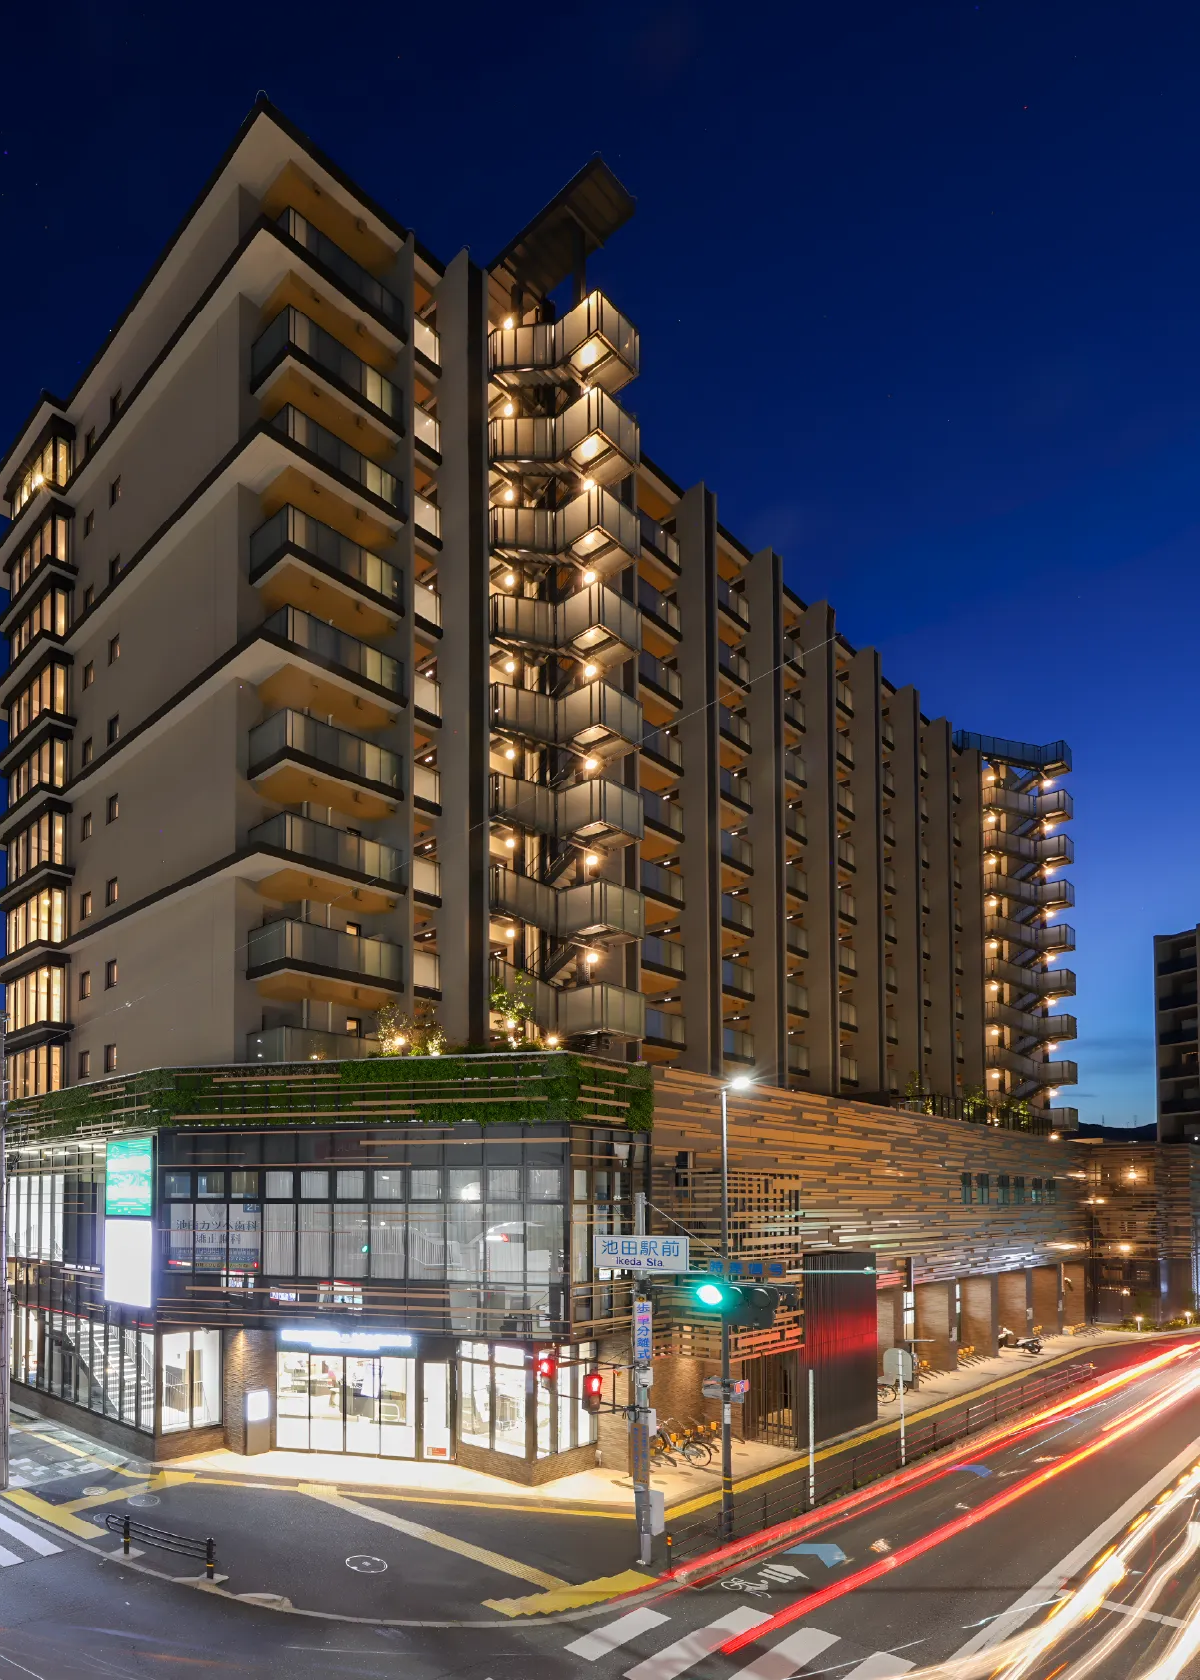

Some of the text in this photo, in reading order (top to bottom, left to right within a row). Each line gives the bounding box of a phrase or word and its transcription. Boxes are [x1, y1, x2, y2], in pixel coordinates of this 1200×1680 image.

[601, 1240, 680, 1257] 池田駅前
[616, 1257, 642, 1266] Ikeda
[636, 1302, 651, 1359] 歩車分離式
